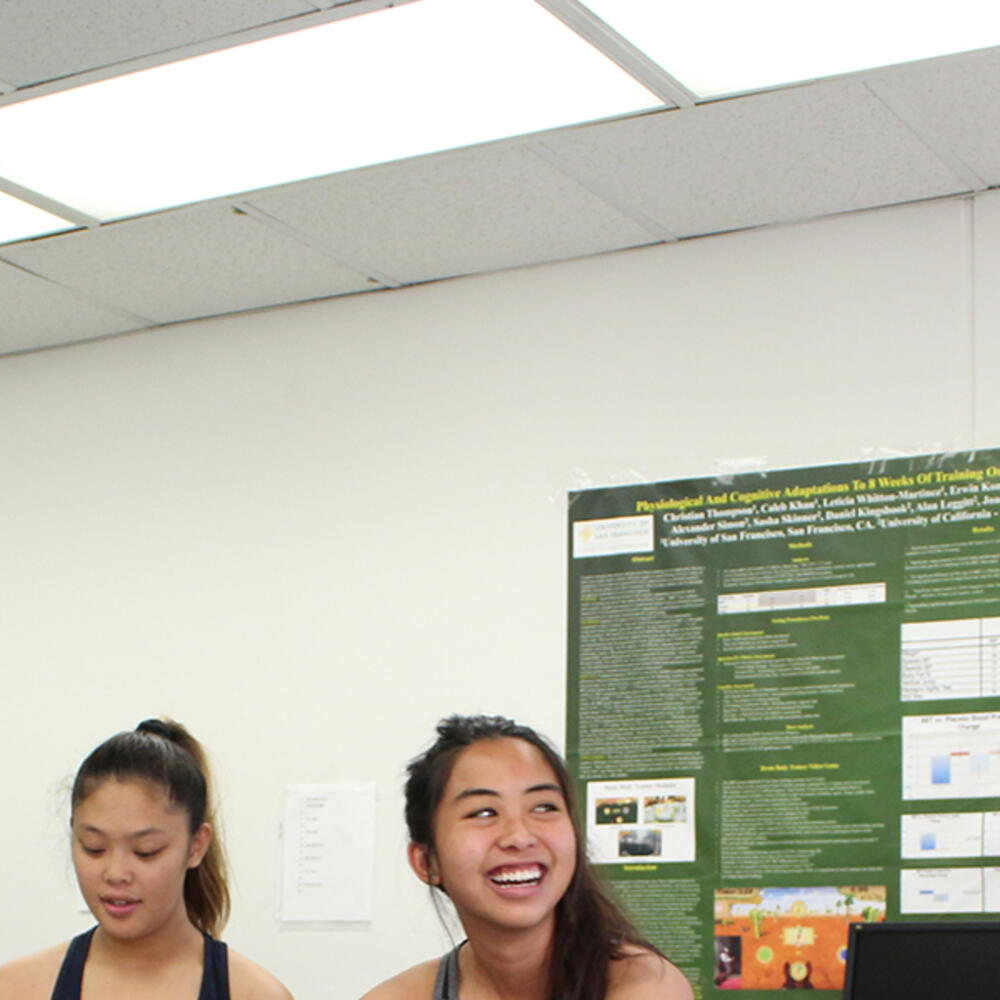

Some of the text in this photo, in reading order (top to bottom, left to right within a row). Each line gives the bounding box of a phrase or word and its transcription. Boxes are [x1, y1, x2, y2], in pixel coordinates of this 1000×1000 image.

[707, 493, 728, 505] And
[729, 488, 782, 505] Cognitive
[783, 482, 850, 499] Adaptations
[853, 479, 866, 491] To
[878, 475, 915, 489] Weeks
[916, 471, 933, 485] Of
[935, 468, 984, 483] Training
[709, 532, 720, 544] of
[721, 531, 738, 543] San
[787, 526, 805, 537] San
[930, 512, 942, 524] of
[942, 509, 992, 522] California
